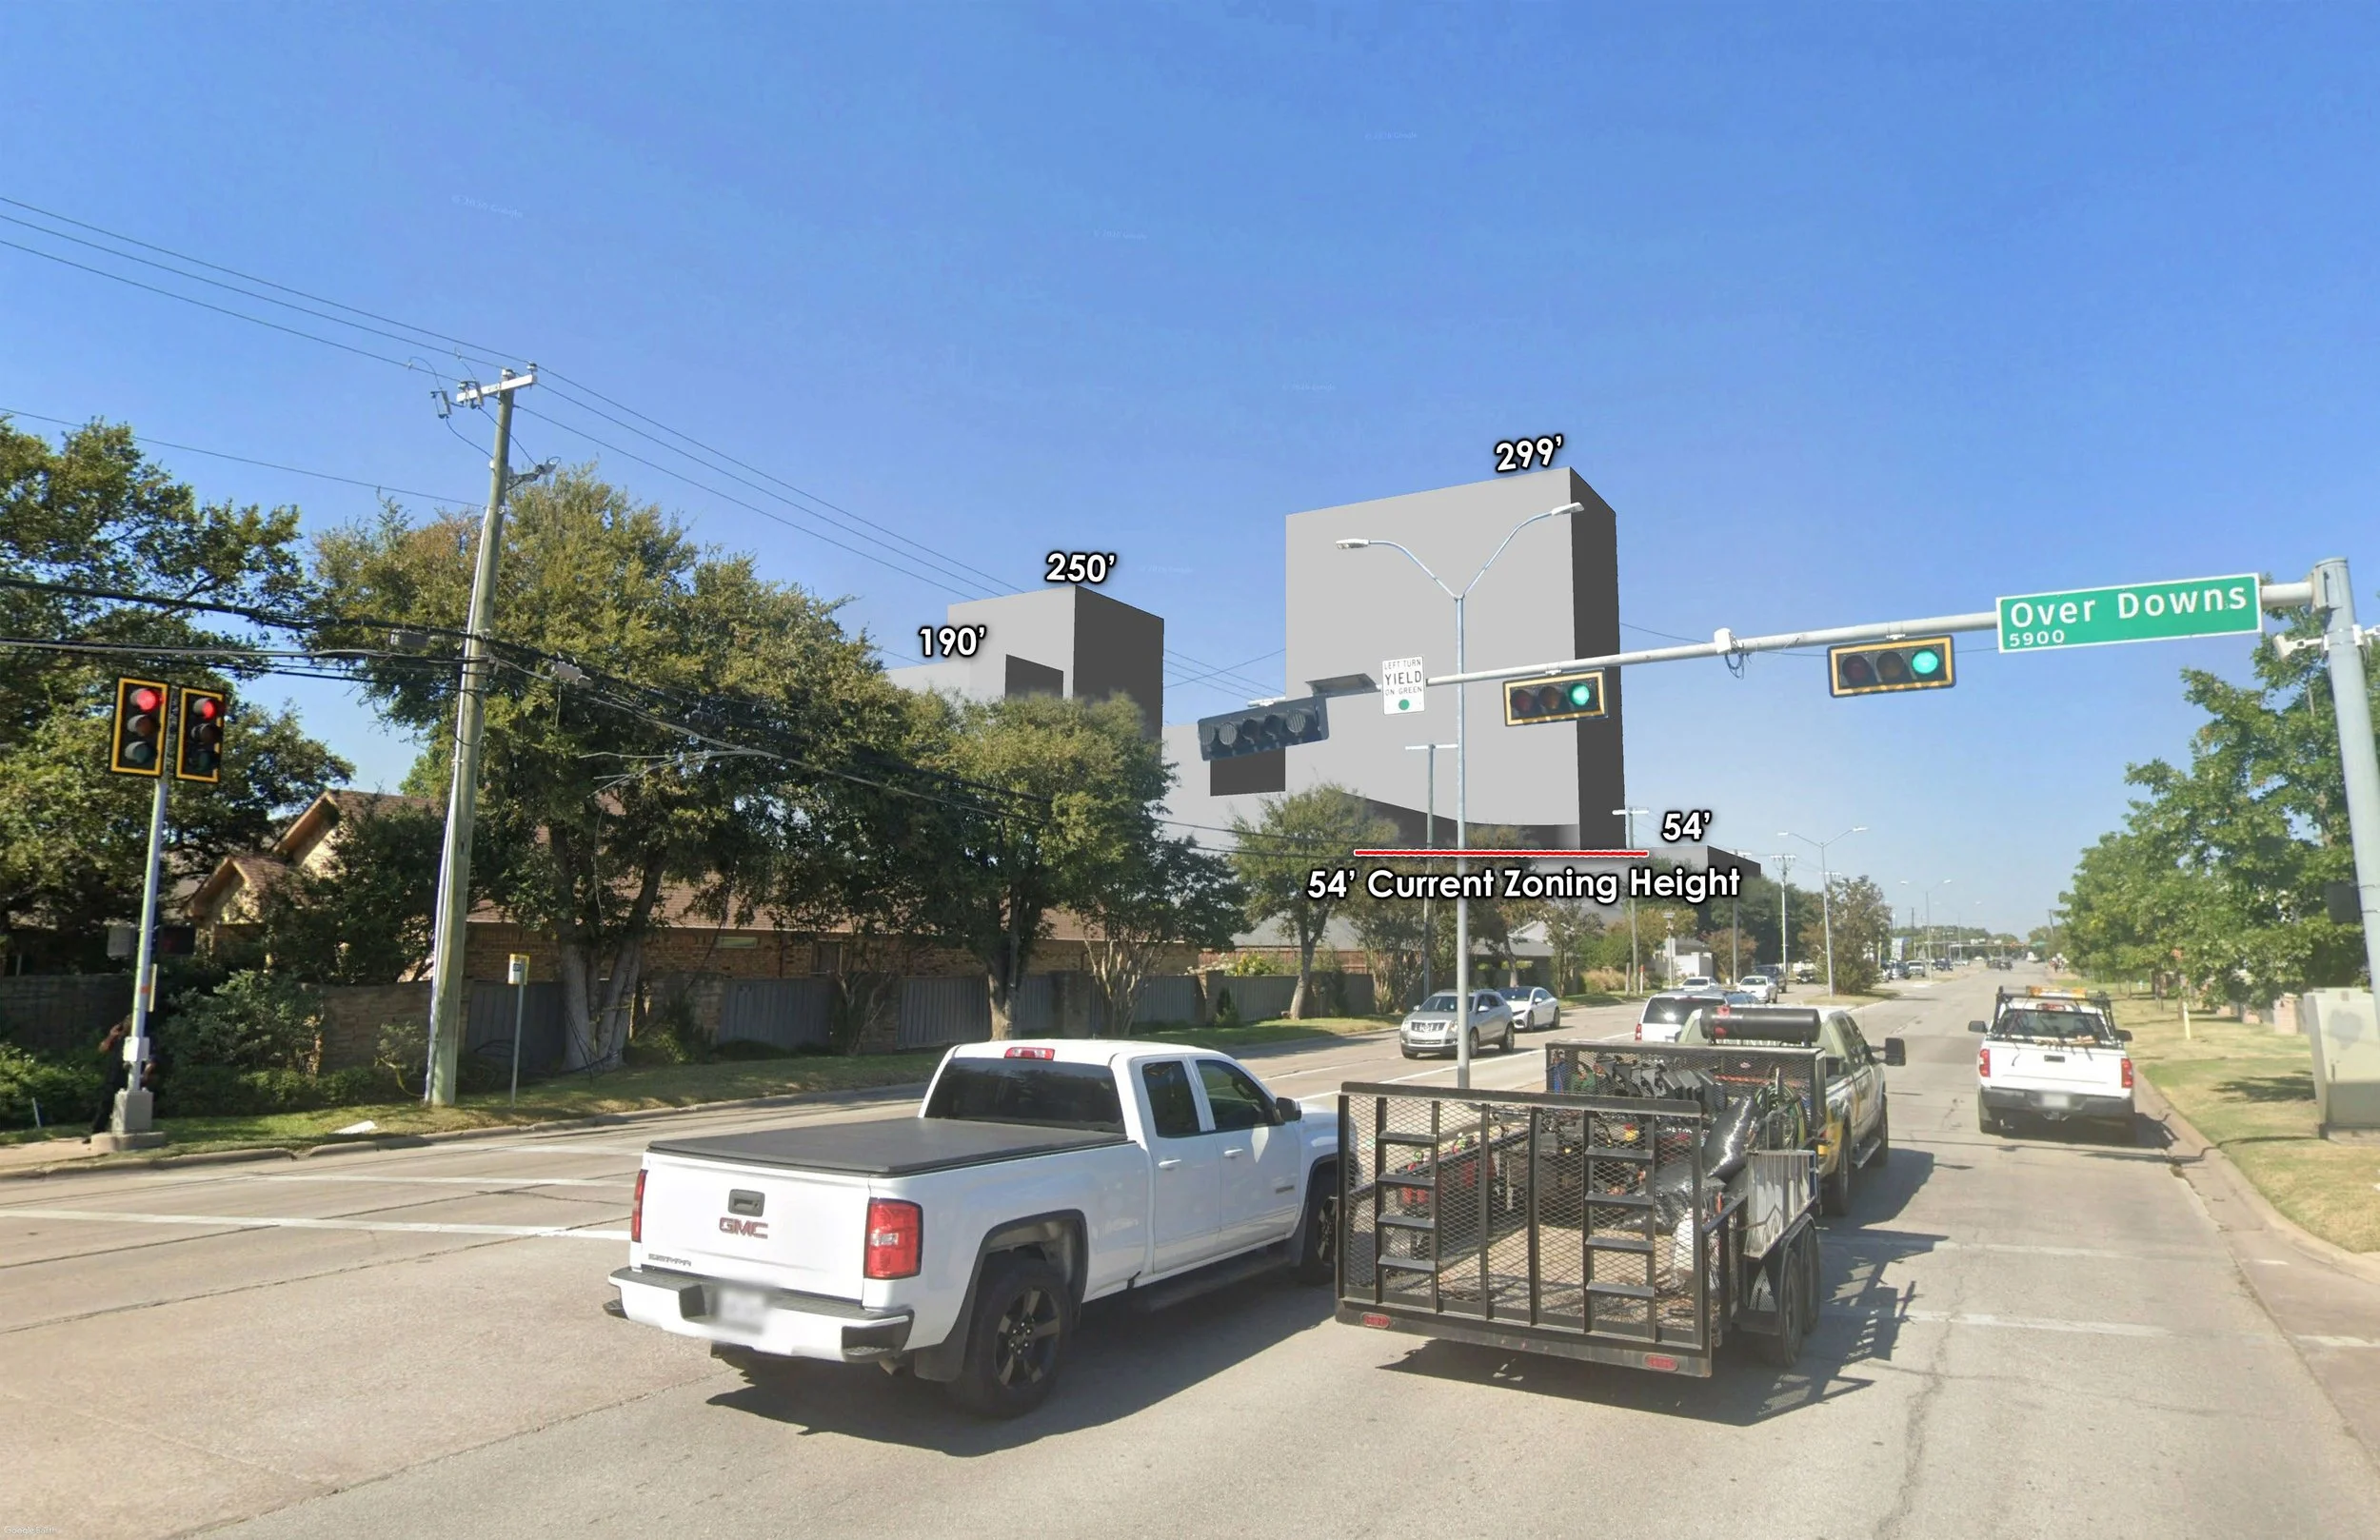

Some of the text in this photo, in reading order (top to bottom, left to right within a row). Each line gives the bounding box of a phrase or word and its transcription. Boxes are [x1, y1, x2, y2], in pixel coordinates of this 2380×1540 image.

[2010, 585, 2247, 628] Over Downs
[2009, 629, 2065, 647] 5900
[1384, 659, 1421, 670] LEFT TURN
[1384, 670, 1422, 686] YIELD
[1385, 685, 1422, 697] ON GREEN
[719, 1216, 768, 1239] GMC
